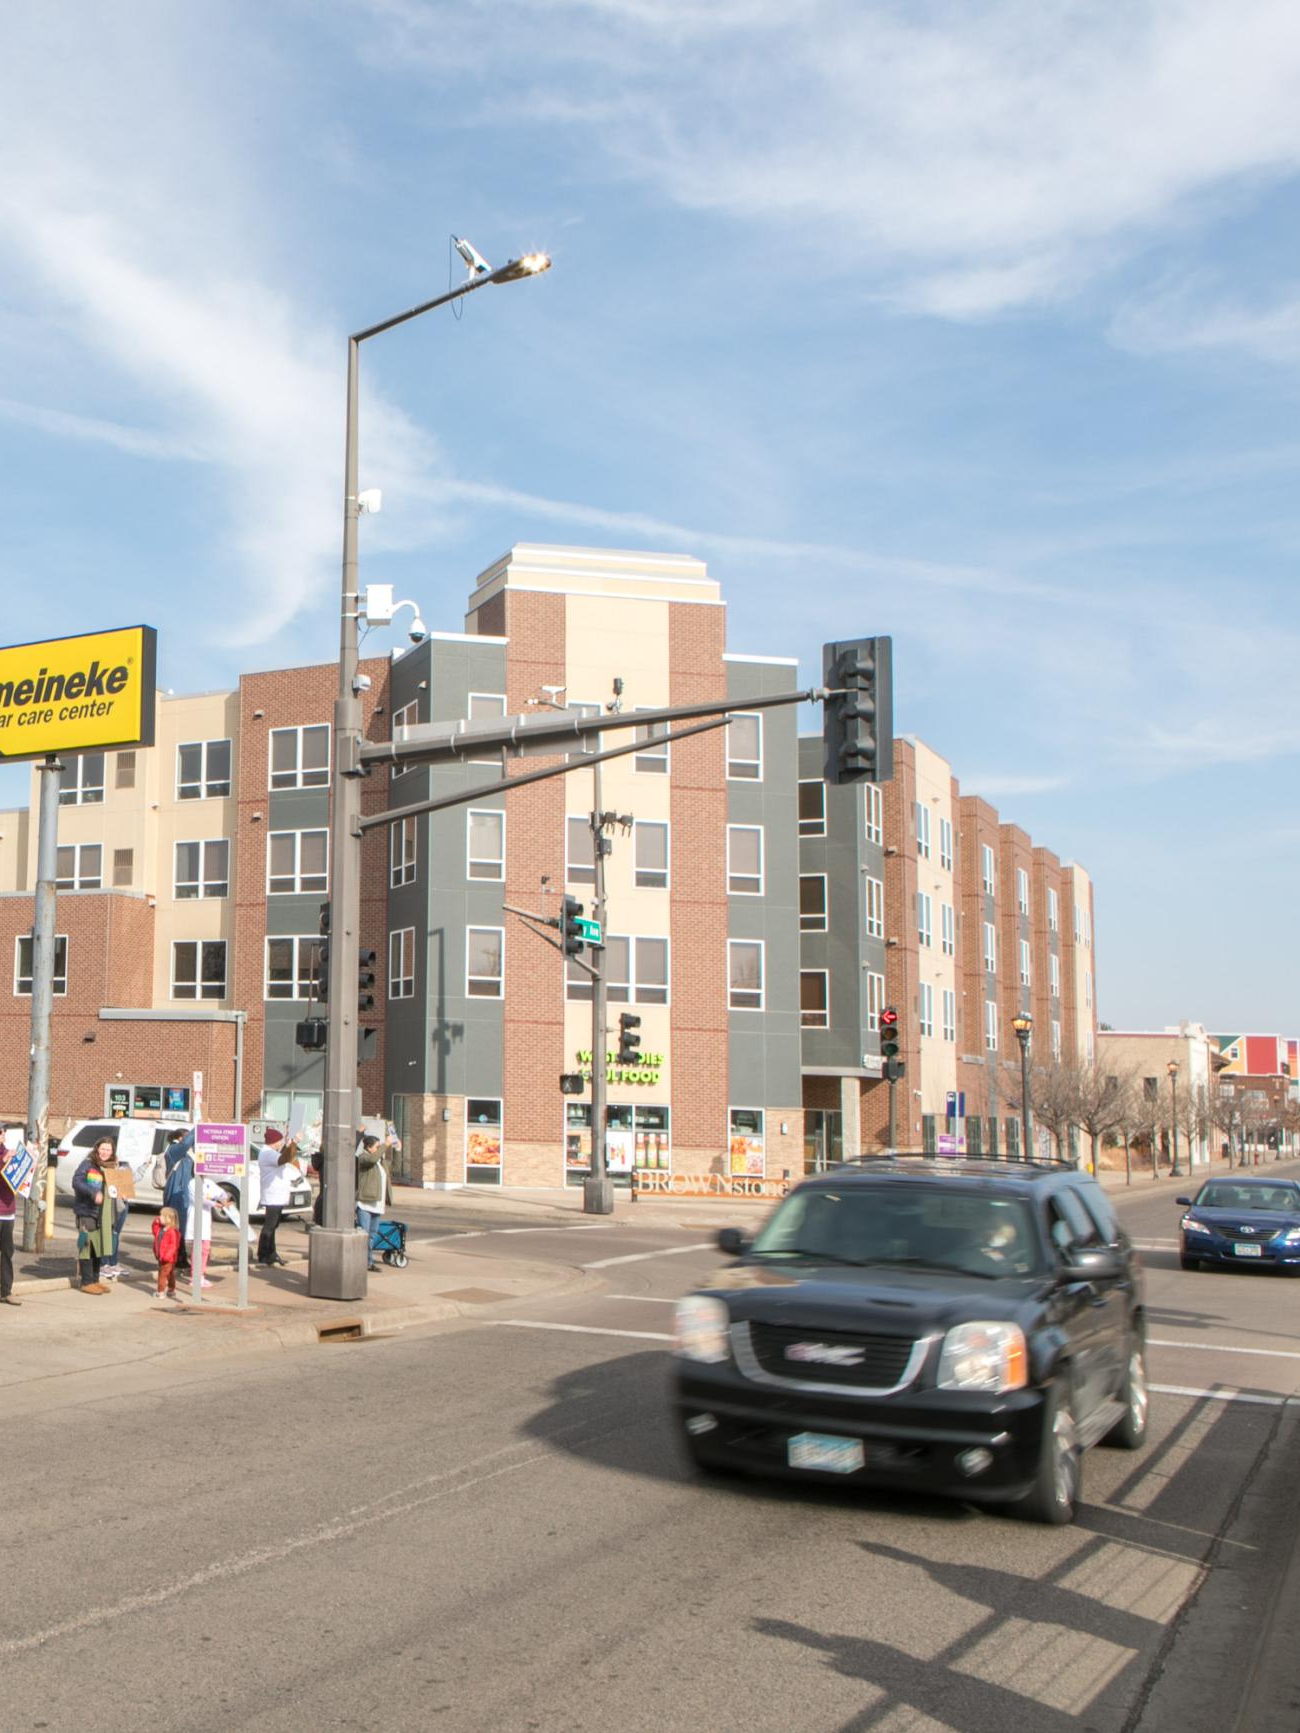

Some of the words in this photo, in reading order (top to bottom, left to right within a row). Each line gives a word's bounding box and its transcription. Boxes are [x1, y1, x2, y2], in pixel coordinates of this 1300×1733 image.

[17, 708, 54, 726] care
[58, 700, 115, 721] center
[621, 1070, 661, 1083] FOOD
